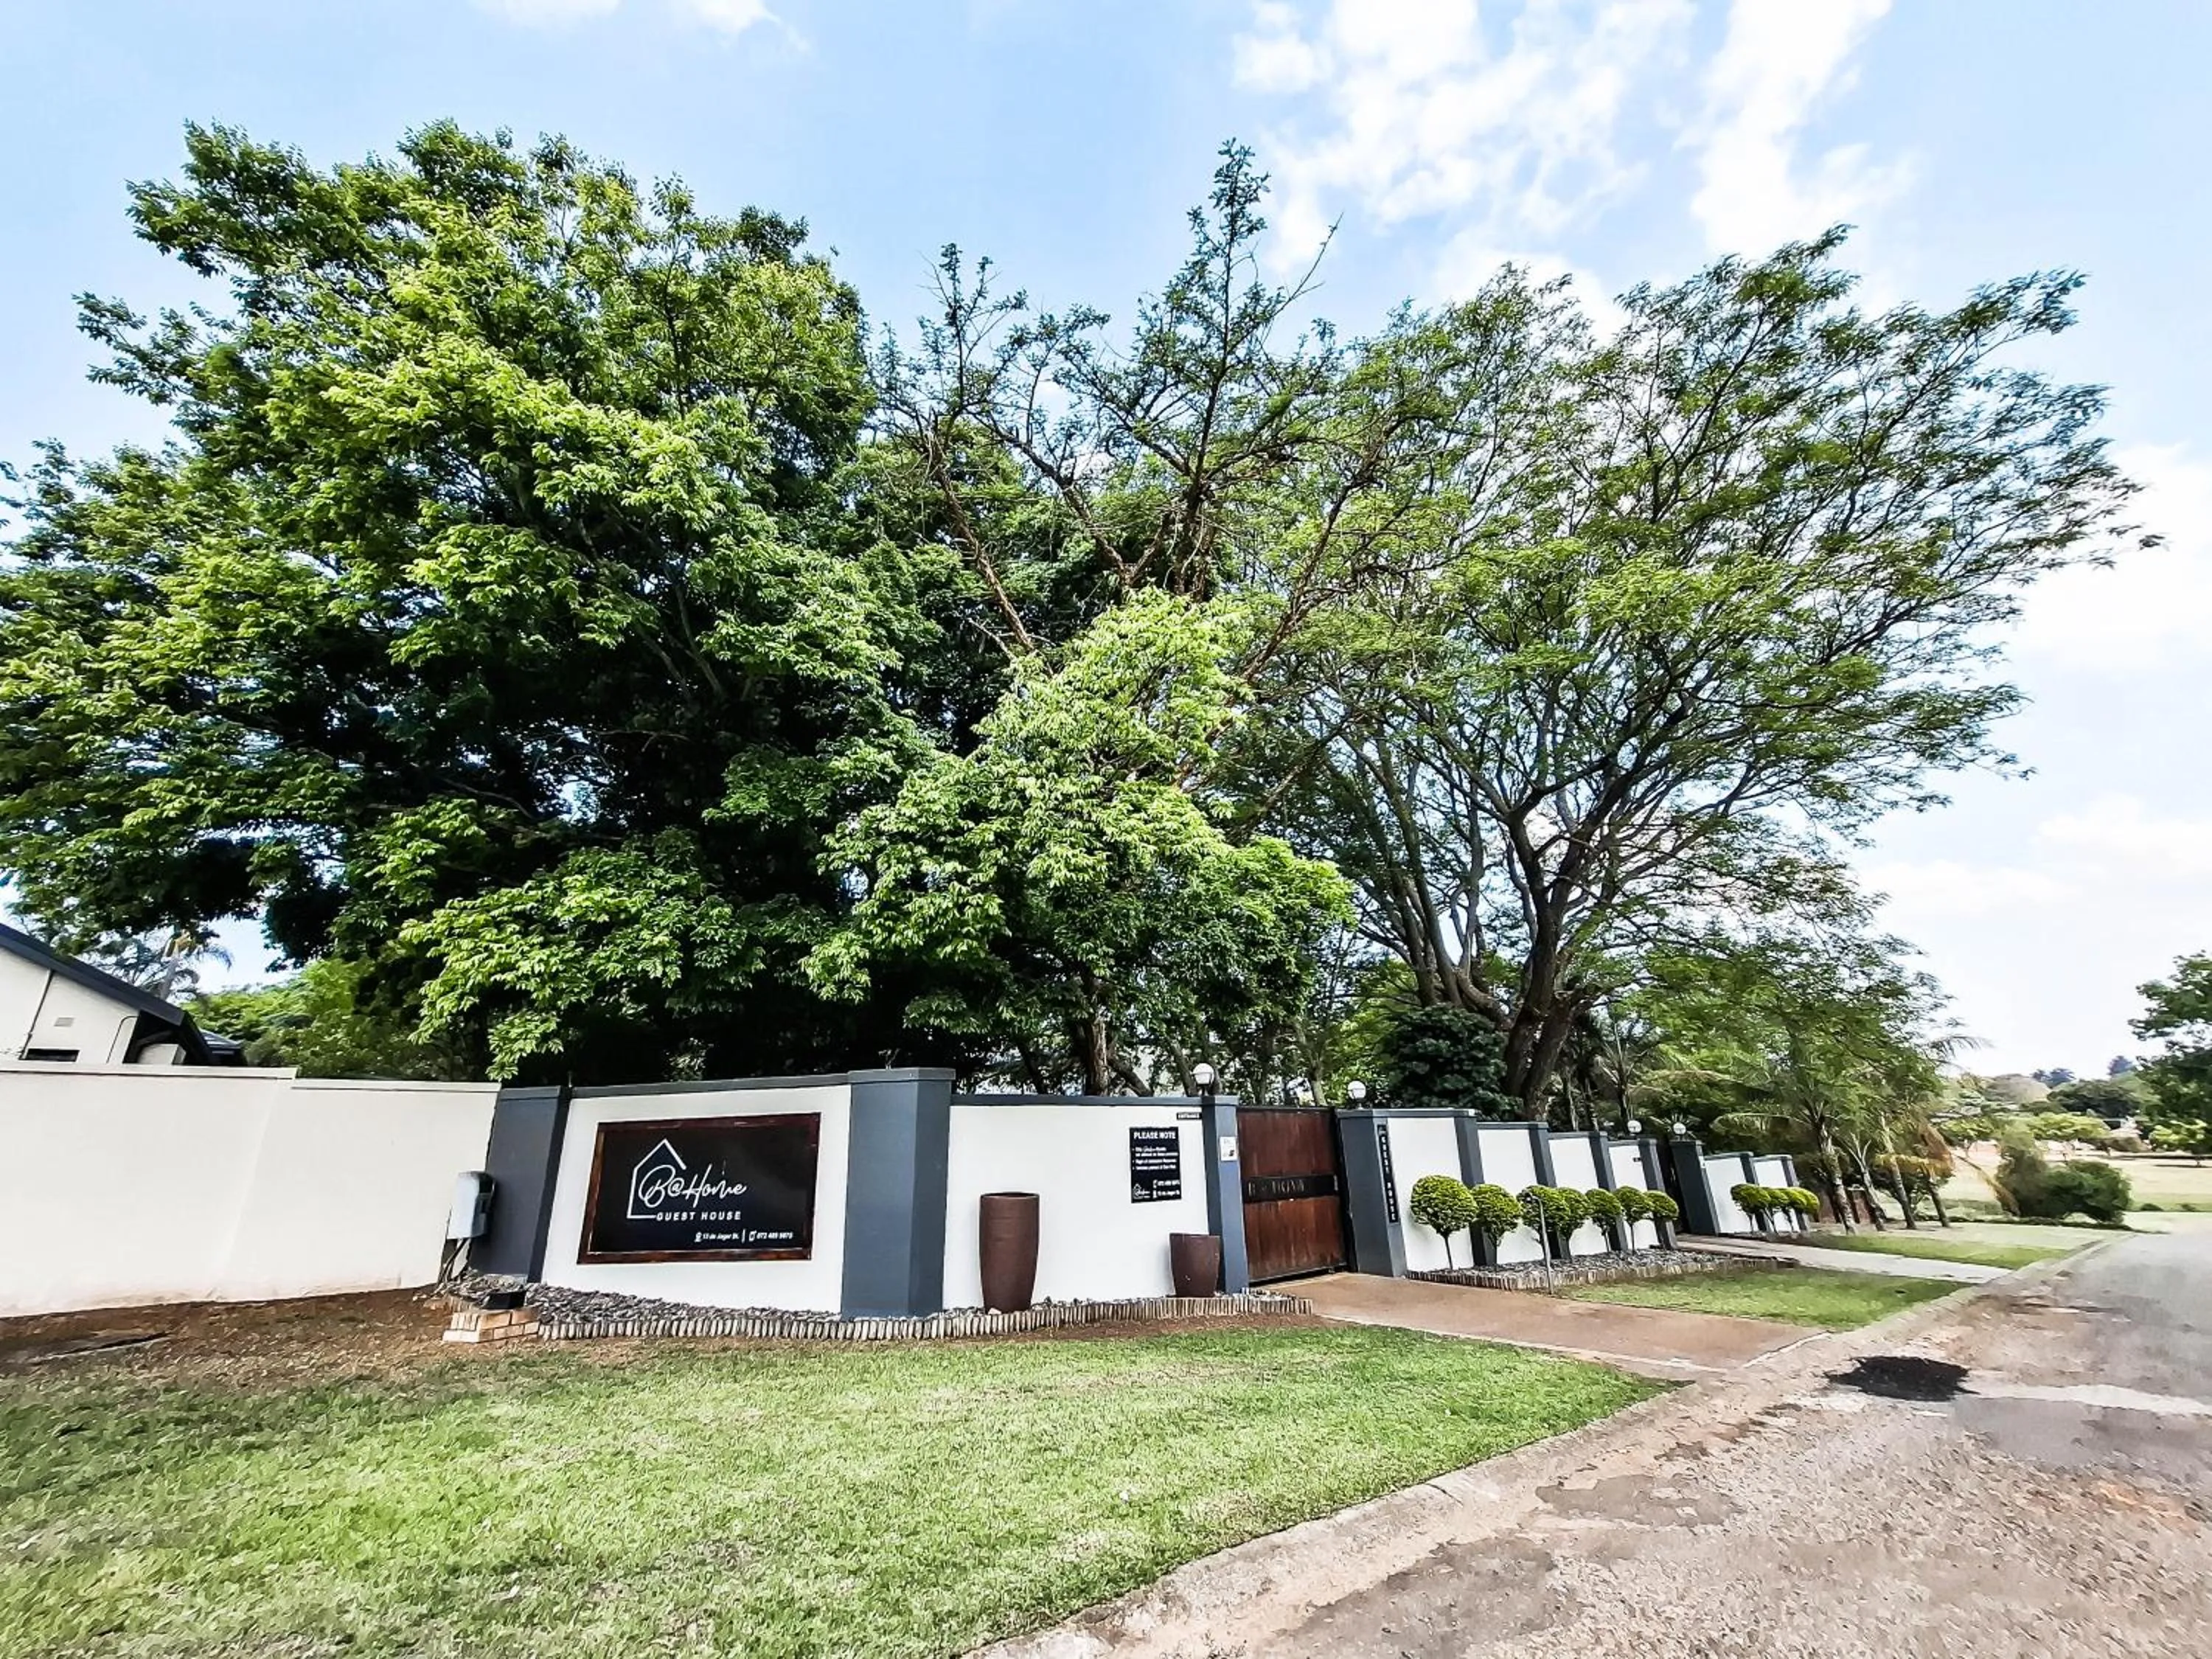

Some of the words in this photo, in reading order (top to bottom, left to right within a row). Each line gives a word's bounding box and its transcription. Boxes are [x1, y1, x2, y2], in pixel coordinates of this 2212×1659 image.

[1133, 1131, 1158, 1139] PLEASE
[1159, 1131, 1176, 1139] NOTE
[655, 1211, 696, 1221] GUEST
[700, 1211, 742, 1221] HOUSE
